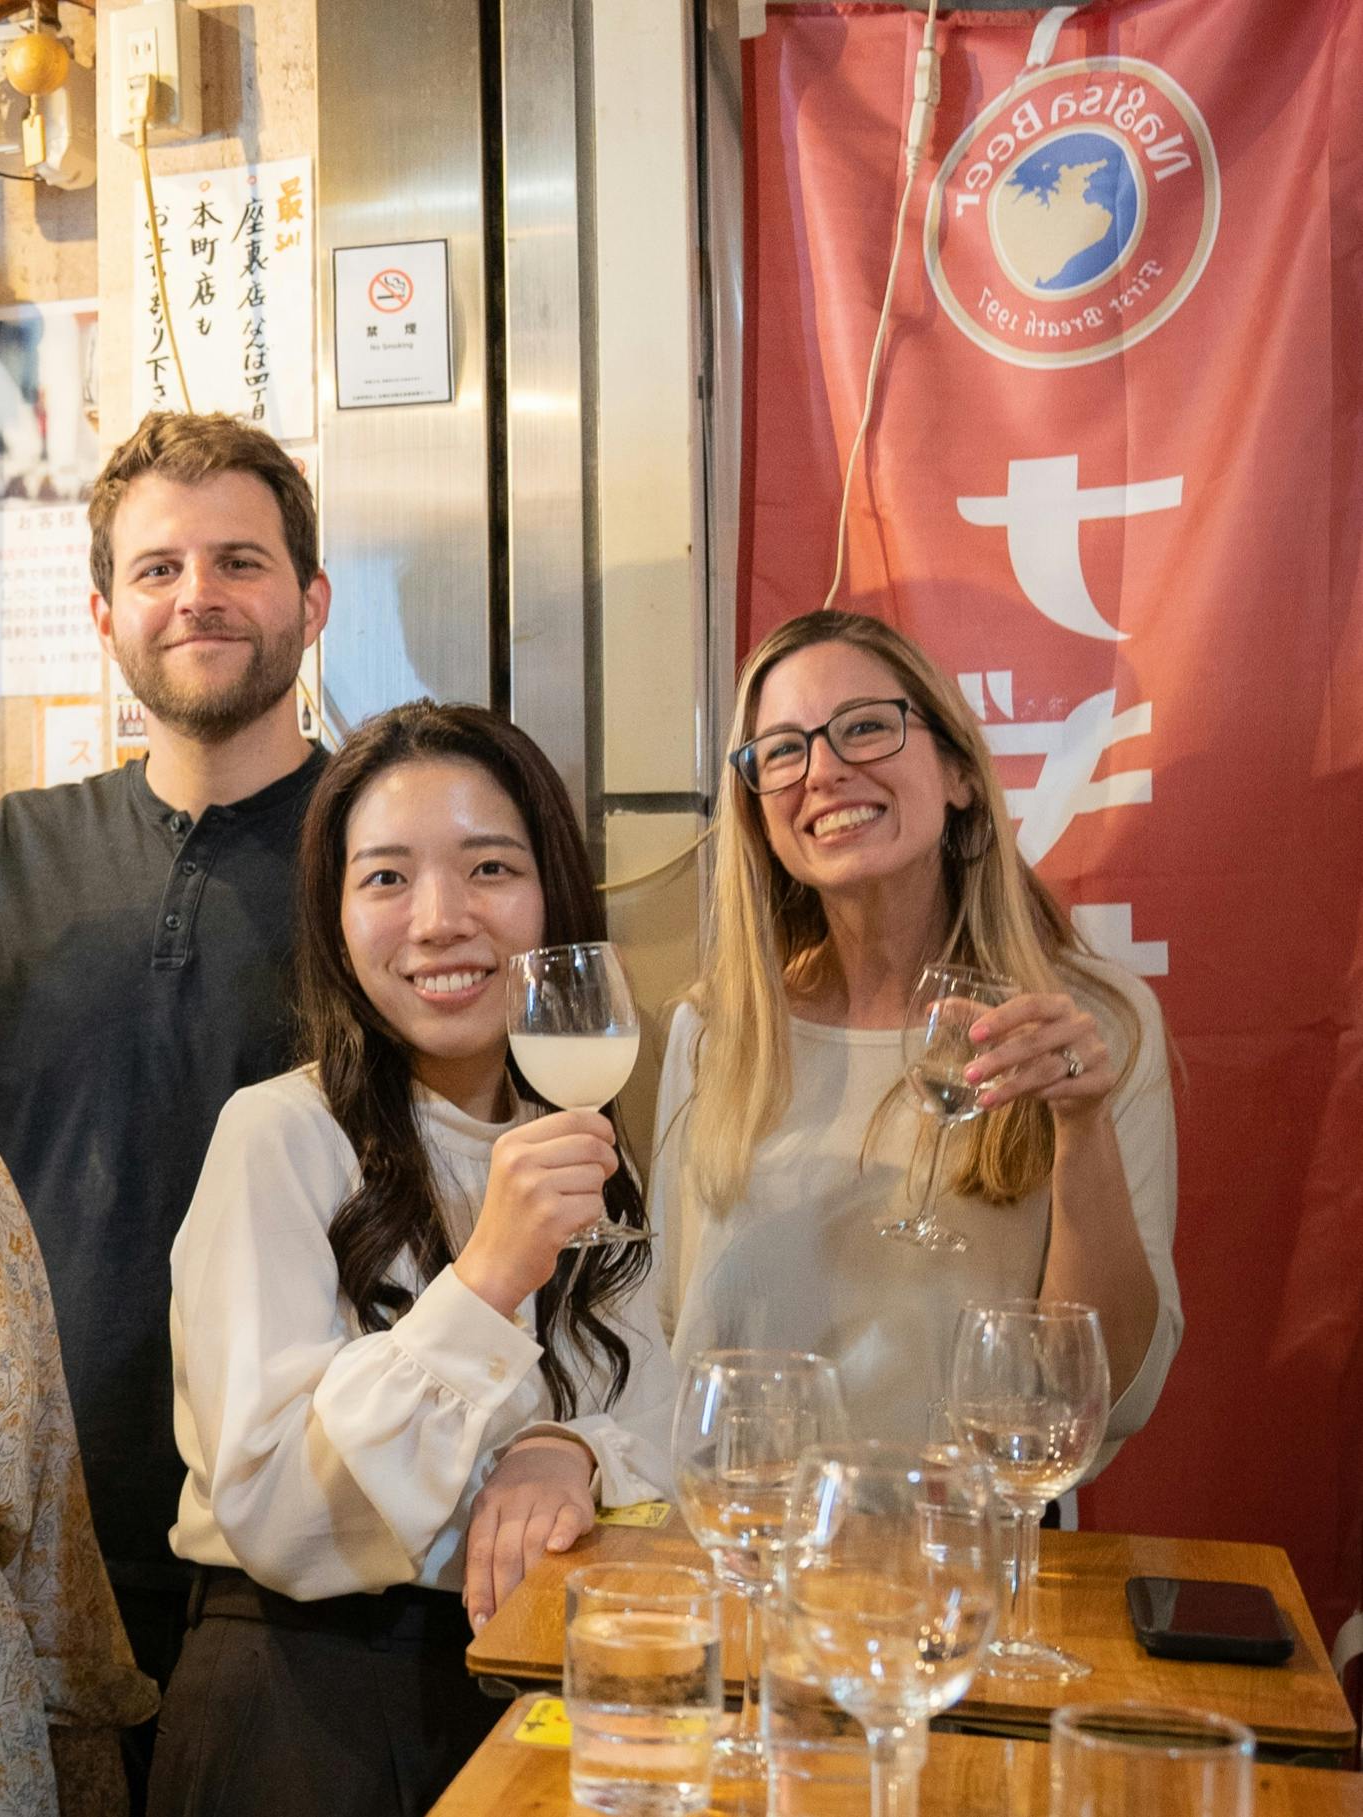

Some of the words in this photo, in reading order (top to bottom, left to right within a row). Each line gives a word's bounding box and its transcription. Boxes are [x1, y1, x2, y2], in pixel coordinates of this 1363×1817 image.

[277, 176, 303, 224] 最
[188, 201, 223, 336] 本町店も
